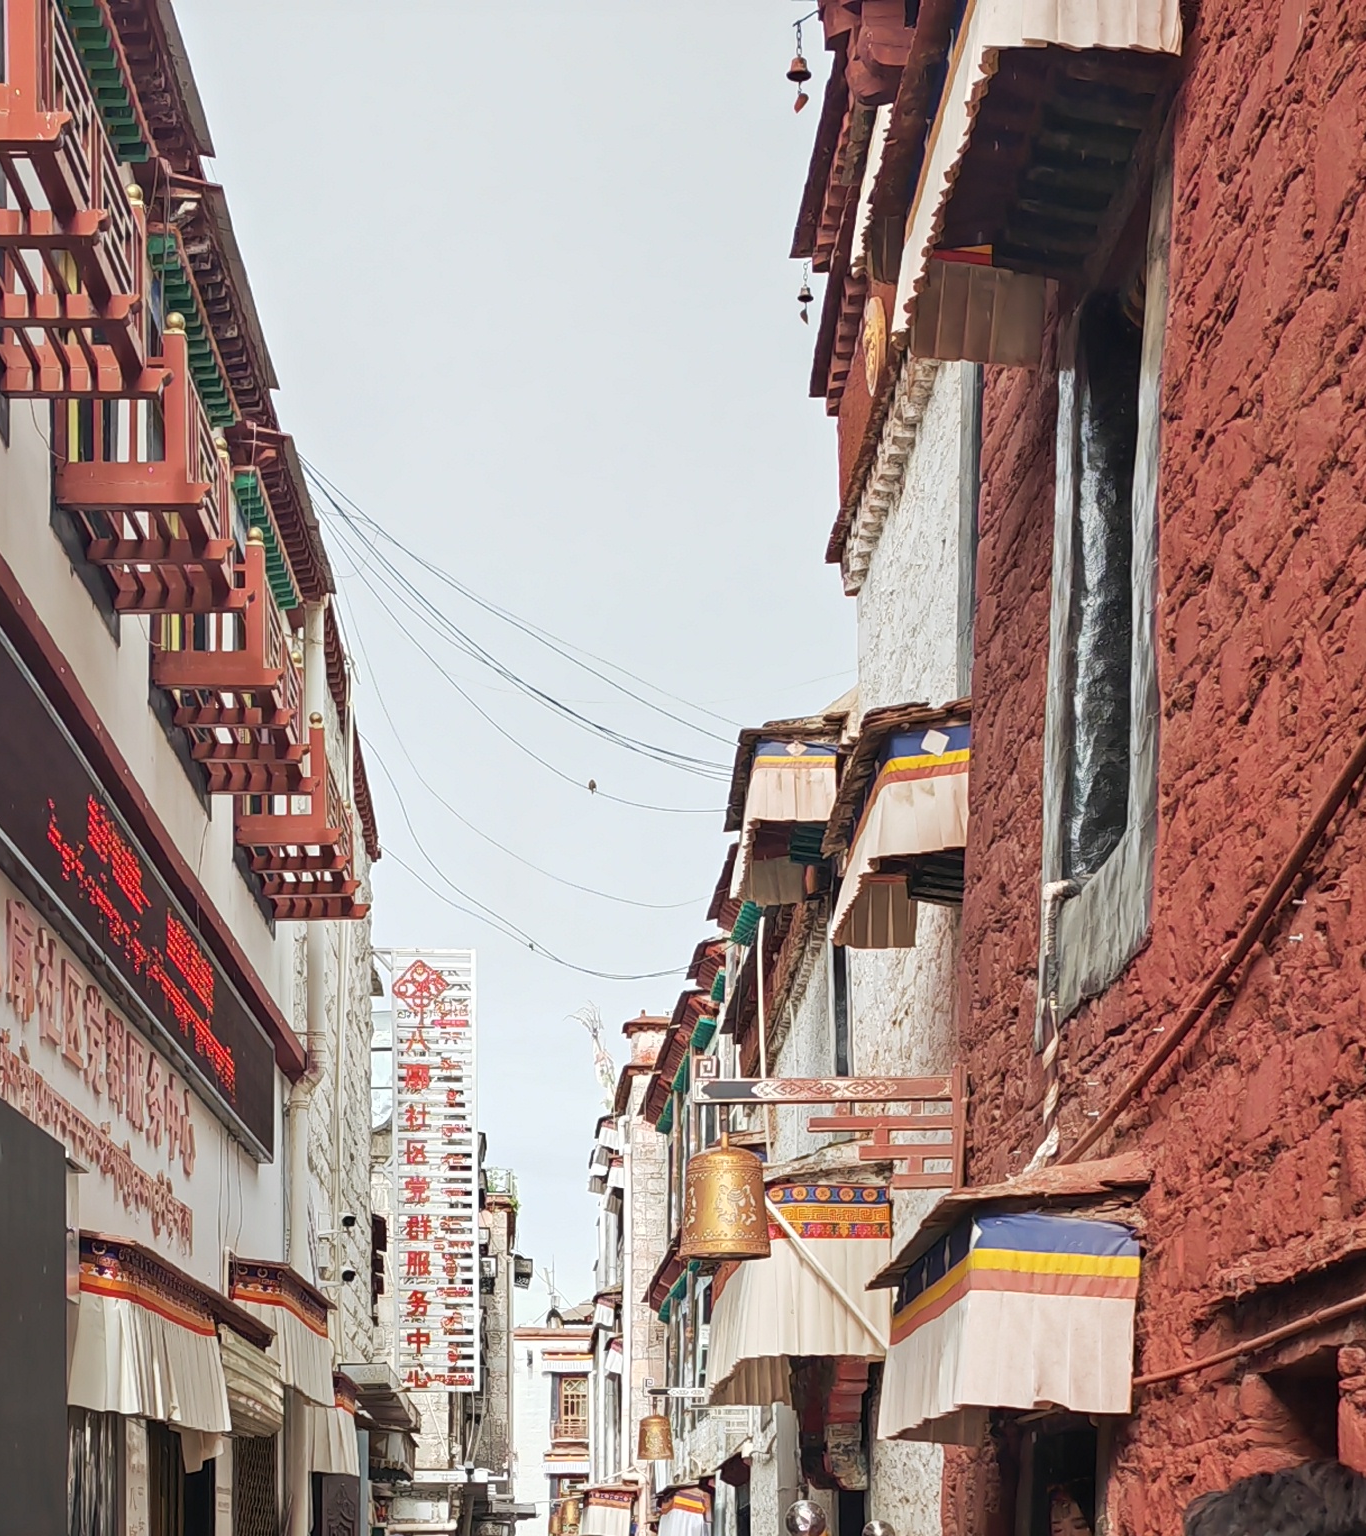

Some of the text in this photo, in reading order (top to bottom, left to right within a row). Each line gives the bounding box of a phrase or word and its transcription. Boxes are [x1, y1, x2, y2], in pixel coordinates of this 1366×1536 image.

[400, 1027, 433, 1389] 八廓社区党群服务中心
